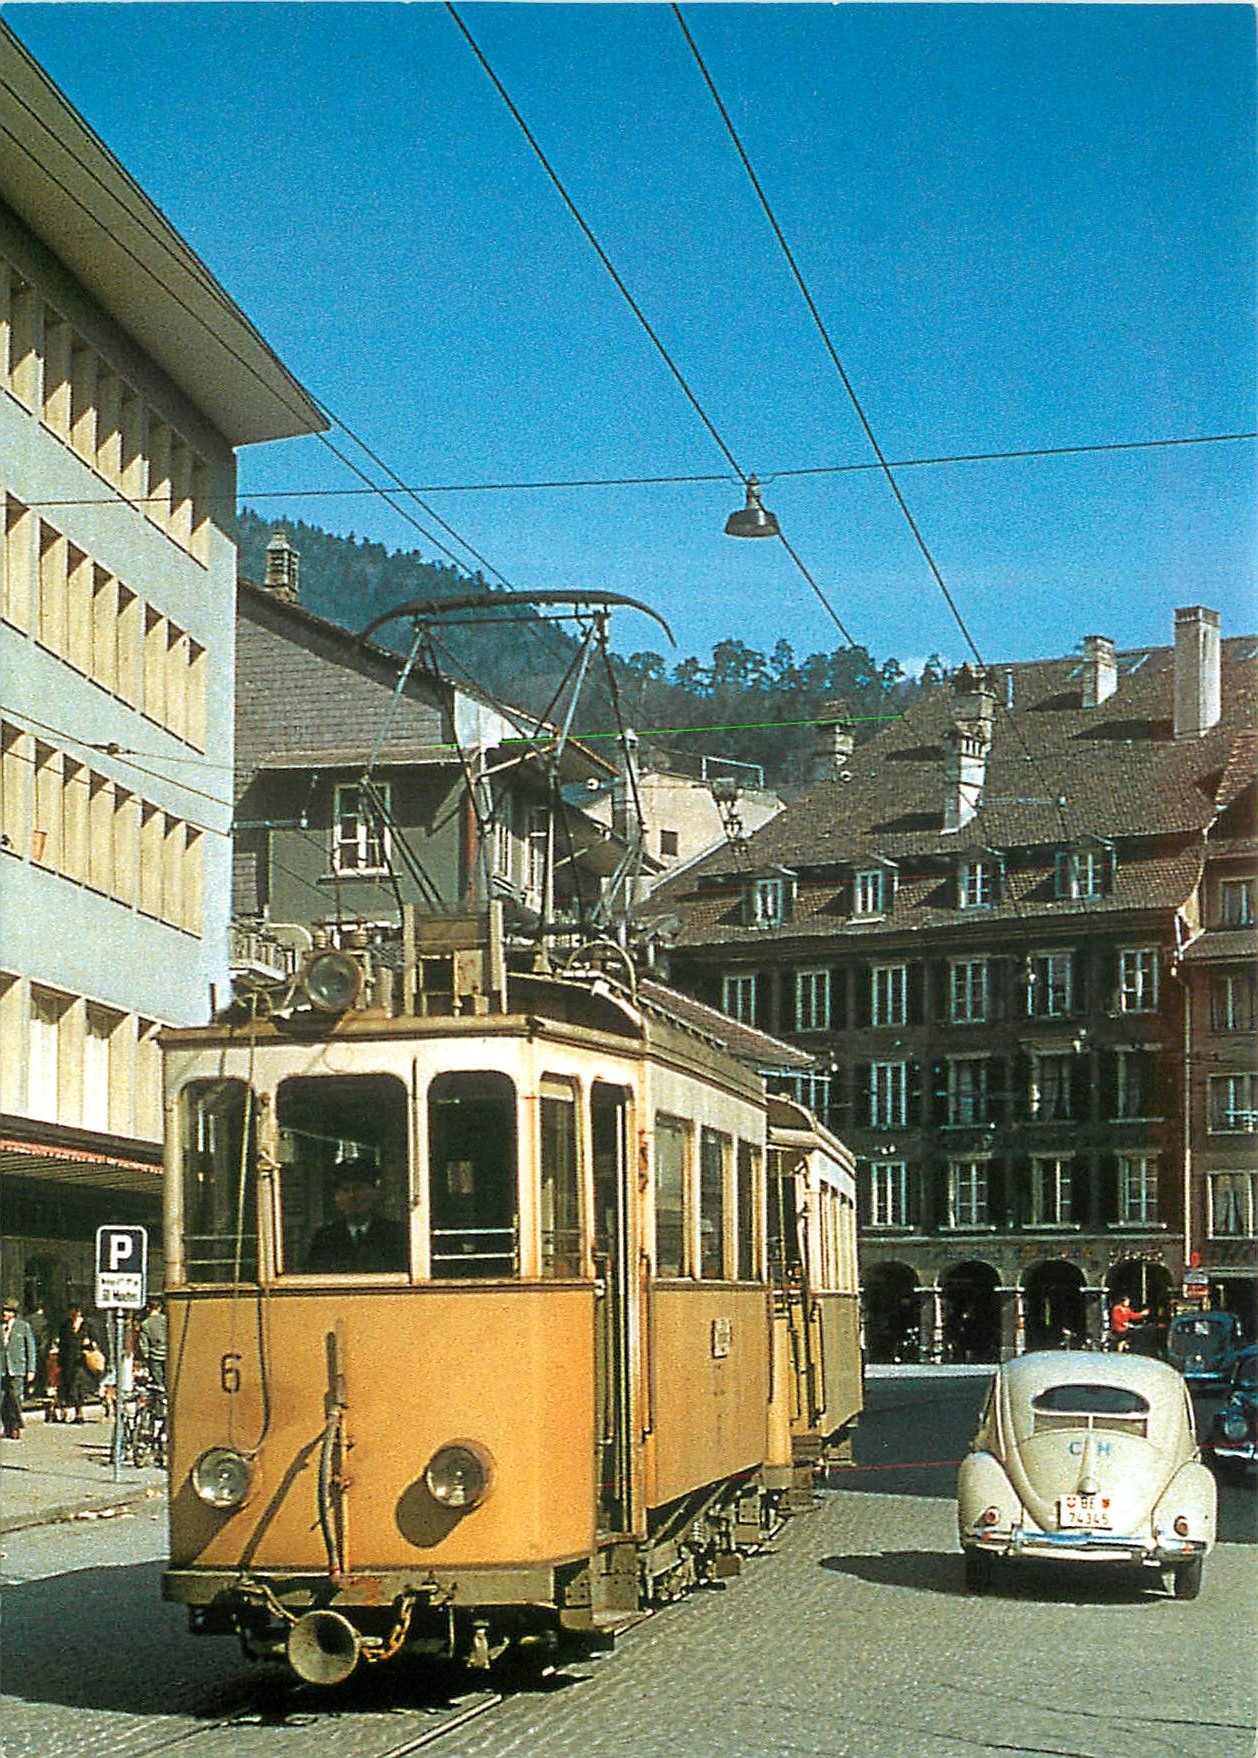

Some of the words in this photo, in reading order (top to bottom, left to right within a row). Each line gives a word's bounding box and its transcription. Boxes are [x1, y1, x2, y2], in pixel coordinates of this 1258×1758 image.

[110, 1234, 133, 1271] P
[221, 1353, 242, 1394] 6
[1080, 1495, 1095, 1510] BE
